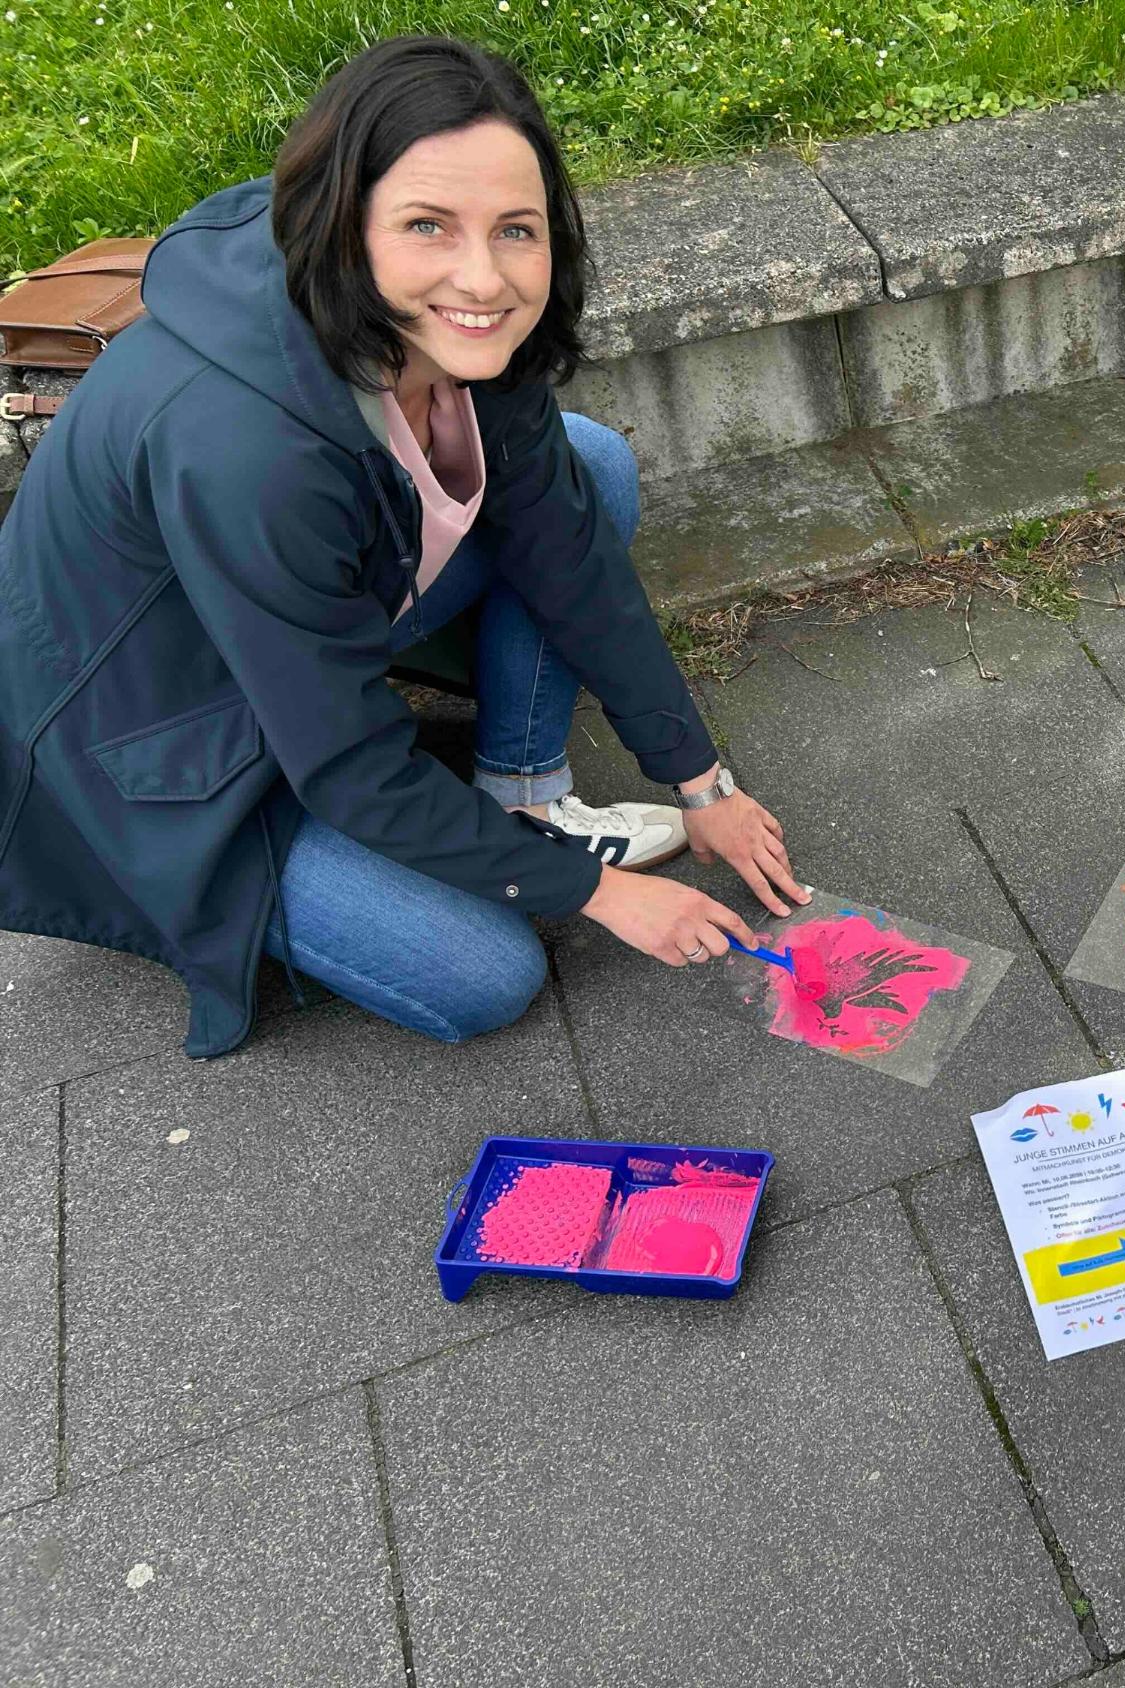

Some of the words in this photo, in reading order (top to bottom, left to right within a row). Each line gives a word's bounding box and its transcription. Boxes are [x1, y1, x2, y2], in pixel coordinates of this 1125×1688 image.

[1013, 1150, 1048, 1164] JUNGE
[1051, 1141, 1096, 1157] STIMMEN
[1097, 1134, 1116, 1147] AUF
[1031, 1157, 1086, 1173] MITMACHKUNST
